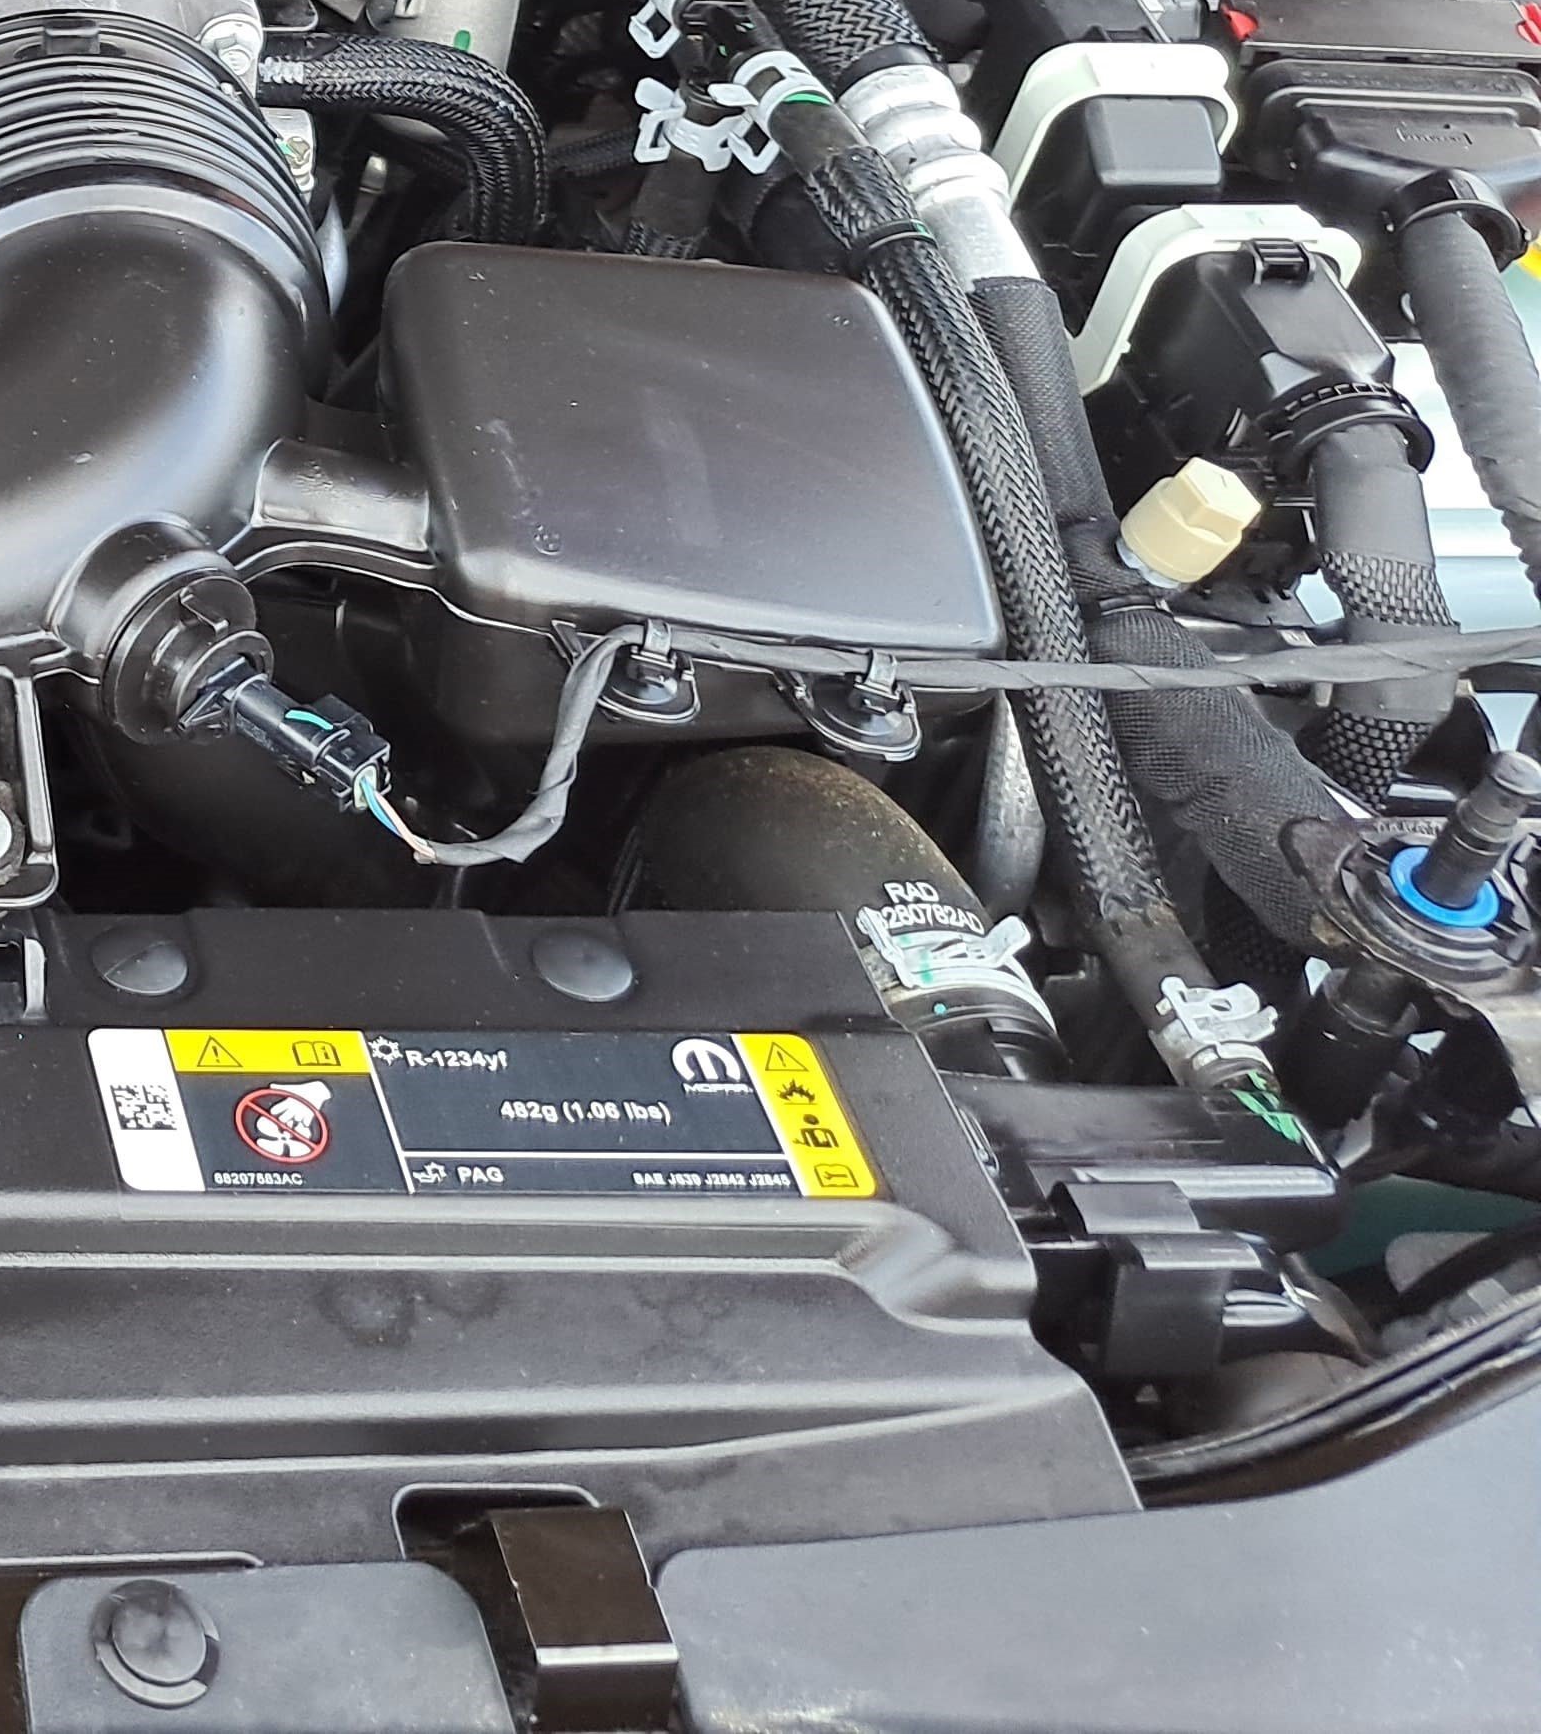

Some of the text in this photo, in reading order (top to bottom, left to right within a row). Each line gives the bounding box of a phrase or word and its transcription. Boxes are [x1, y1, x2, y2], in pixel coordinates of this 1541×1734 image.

[883, 882, 940, 904] RAD
[405, 1049, 508, 1072] R-1234yf
[500, 1100, 671, 1126] 482g (1.06 lbs)
[456, 1166, 505, 1184] PAG
[633, 1172, 665, 1187] SAE
